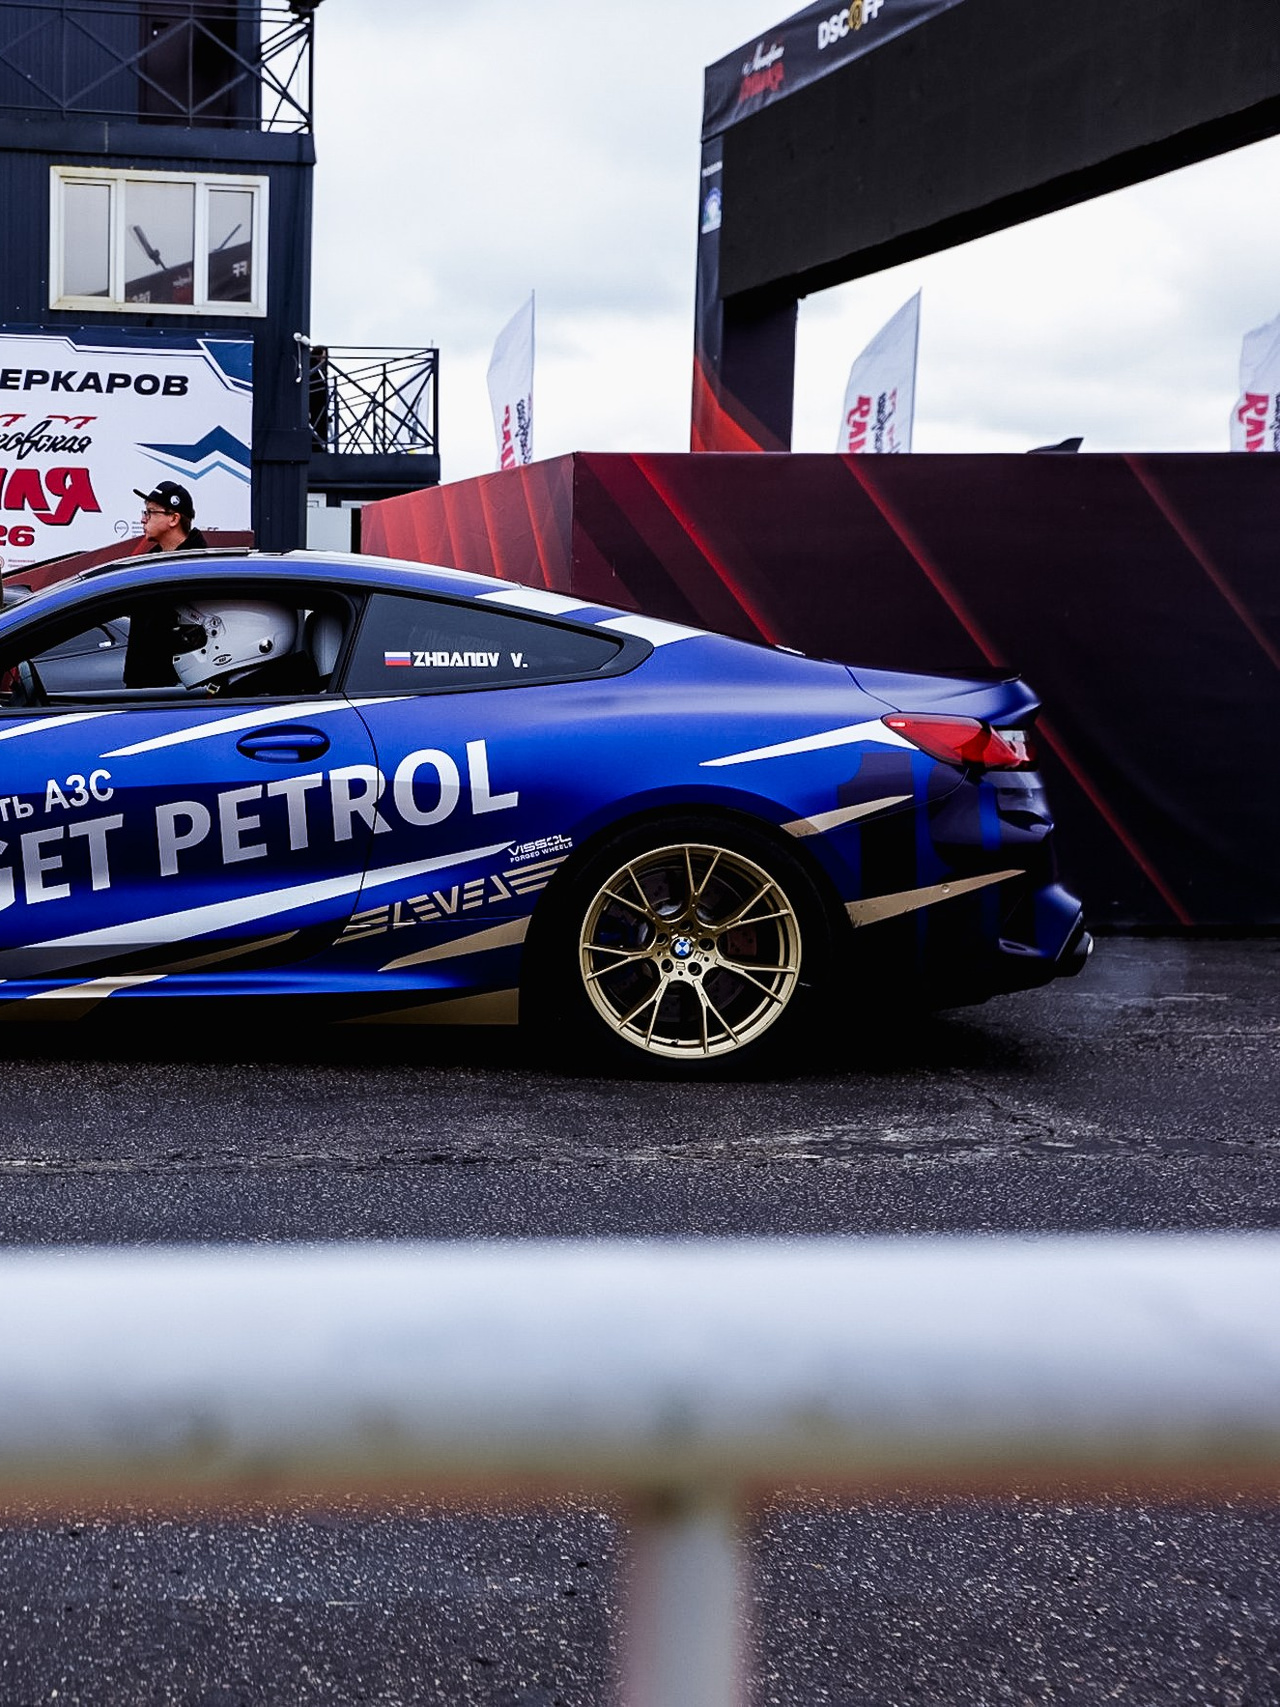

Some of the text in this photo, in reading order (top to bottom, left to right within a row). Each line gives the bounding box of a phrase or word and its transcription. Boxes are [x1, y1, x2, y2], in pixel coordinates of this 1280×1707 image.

[413, 651, 529, 668] ZHDANOV V.
[44, 768, 114, 814] АЗС
[155, 739, 519, 877] PETROL
[510, 841, 573, 863] FORGED WHEELS
